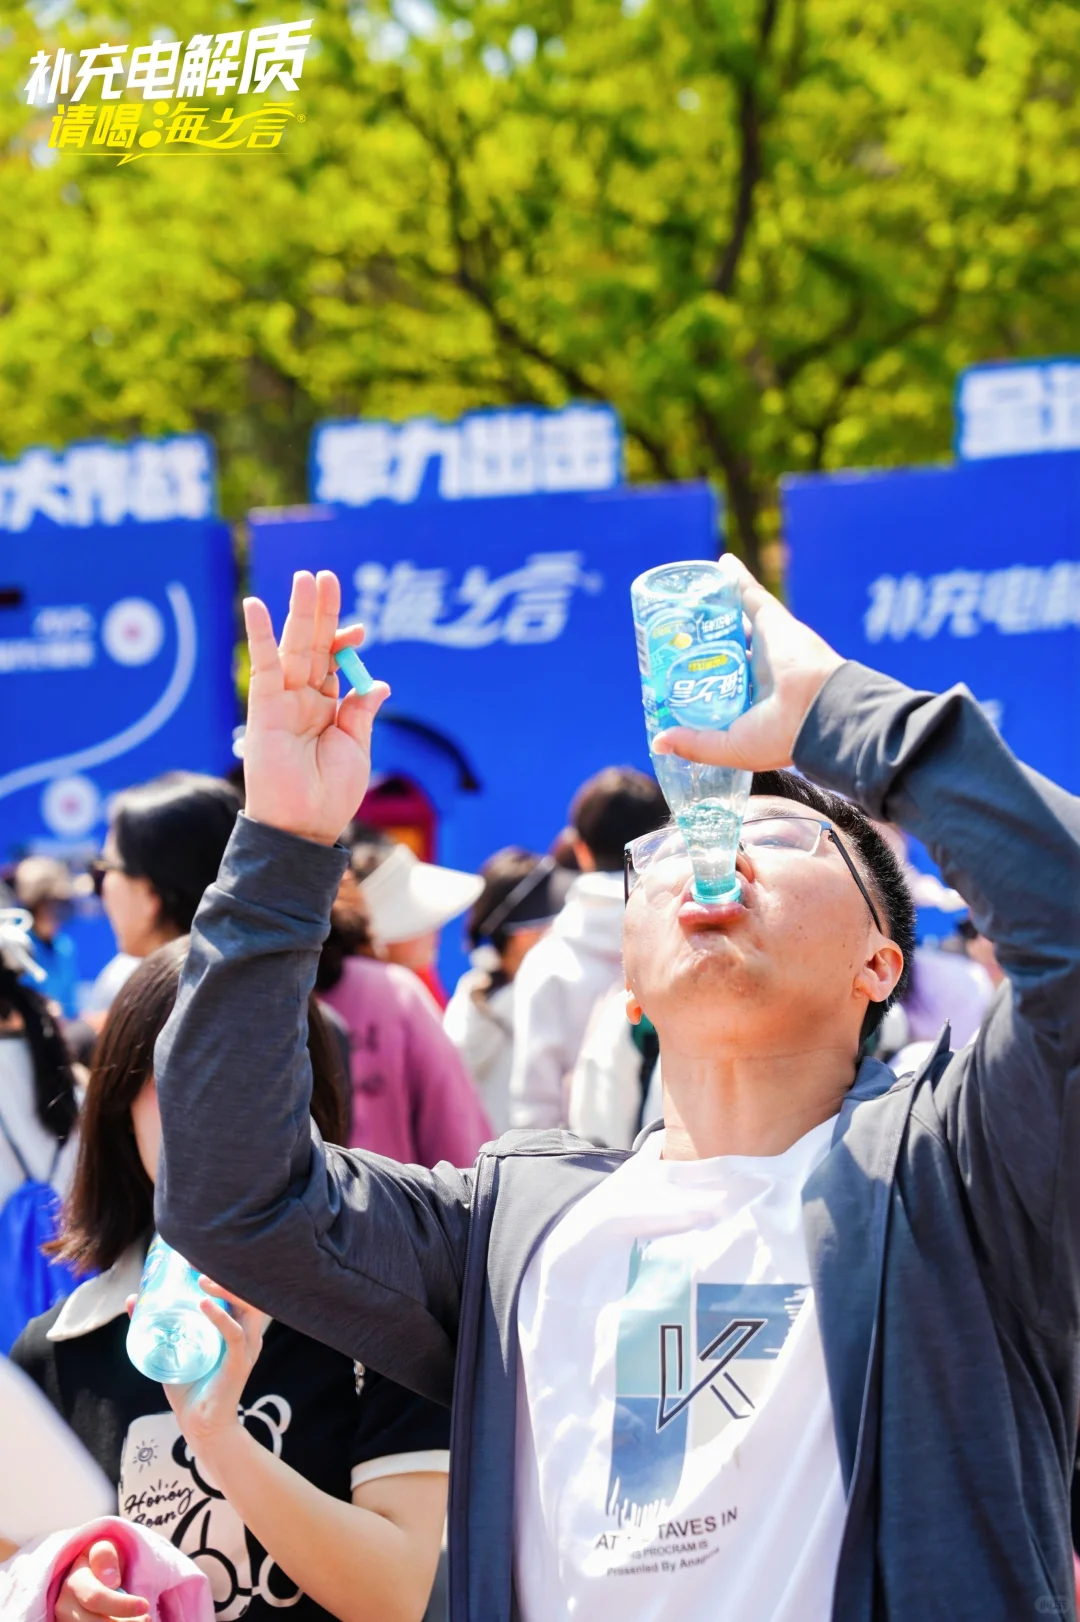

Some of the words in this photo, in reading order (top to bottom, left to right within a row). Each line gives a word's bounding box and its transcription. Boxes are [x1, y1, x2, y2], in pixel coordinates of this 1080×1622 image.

[341, 550, 585, 651] 海之言
[668, 662, 745, 708] 海之言
[124, 1486, 195, 1515] Honey
[658, 1515, 717, 1541] TAVES
[607, 1562, 659, 1578] Presented
[661, 1560, 677, 1574] By
